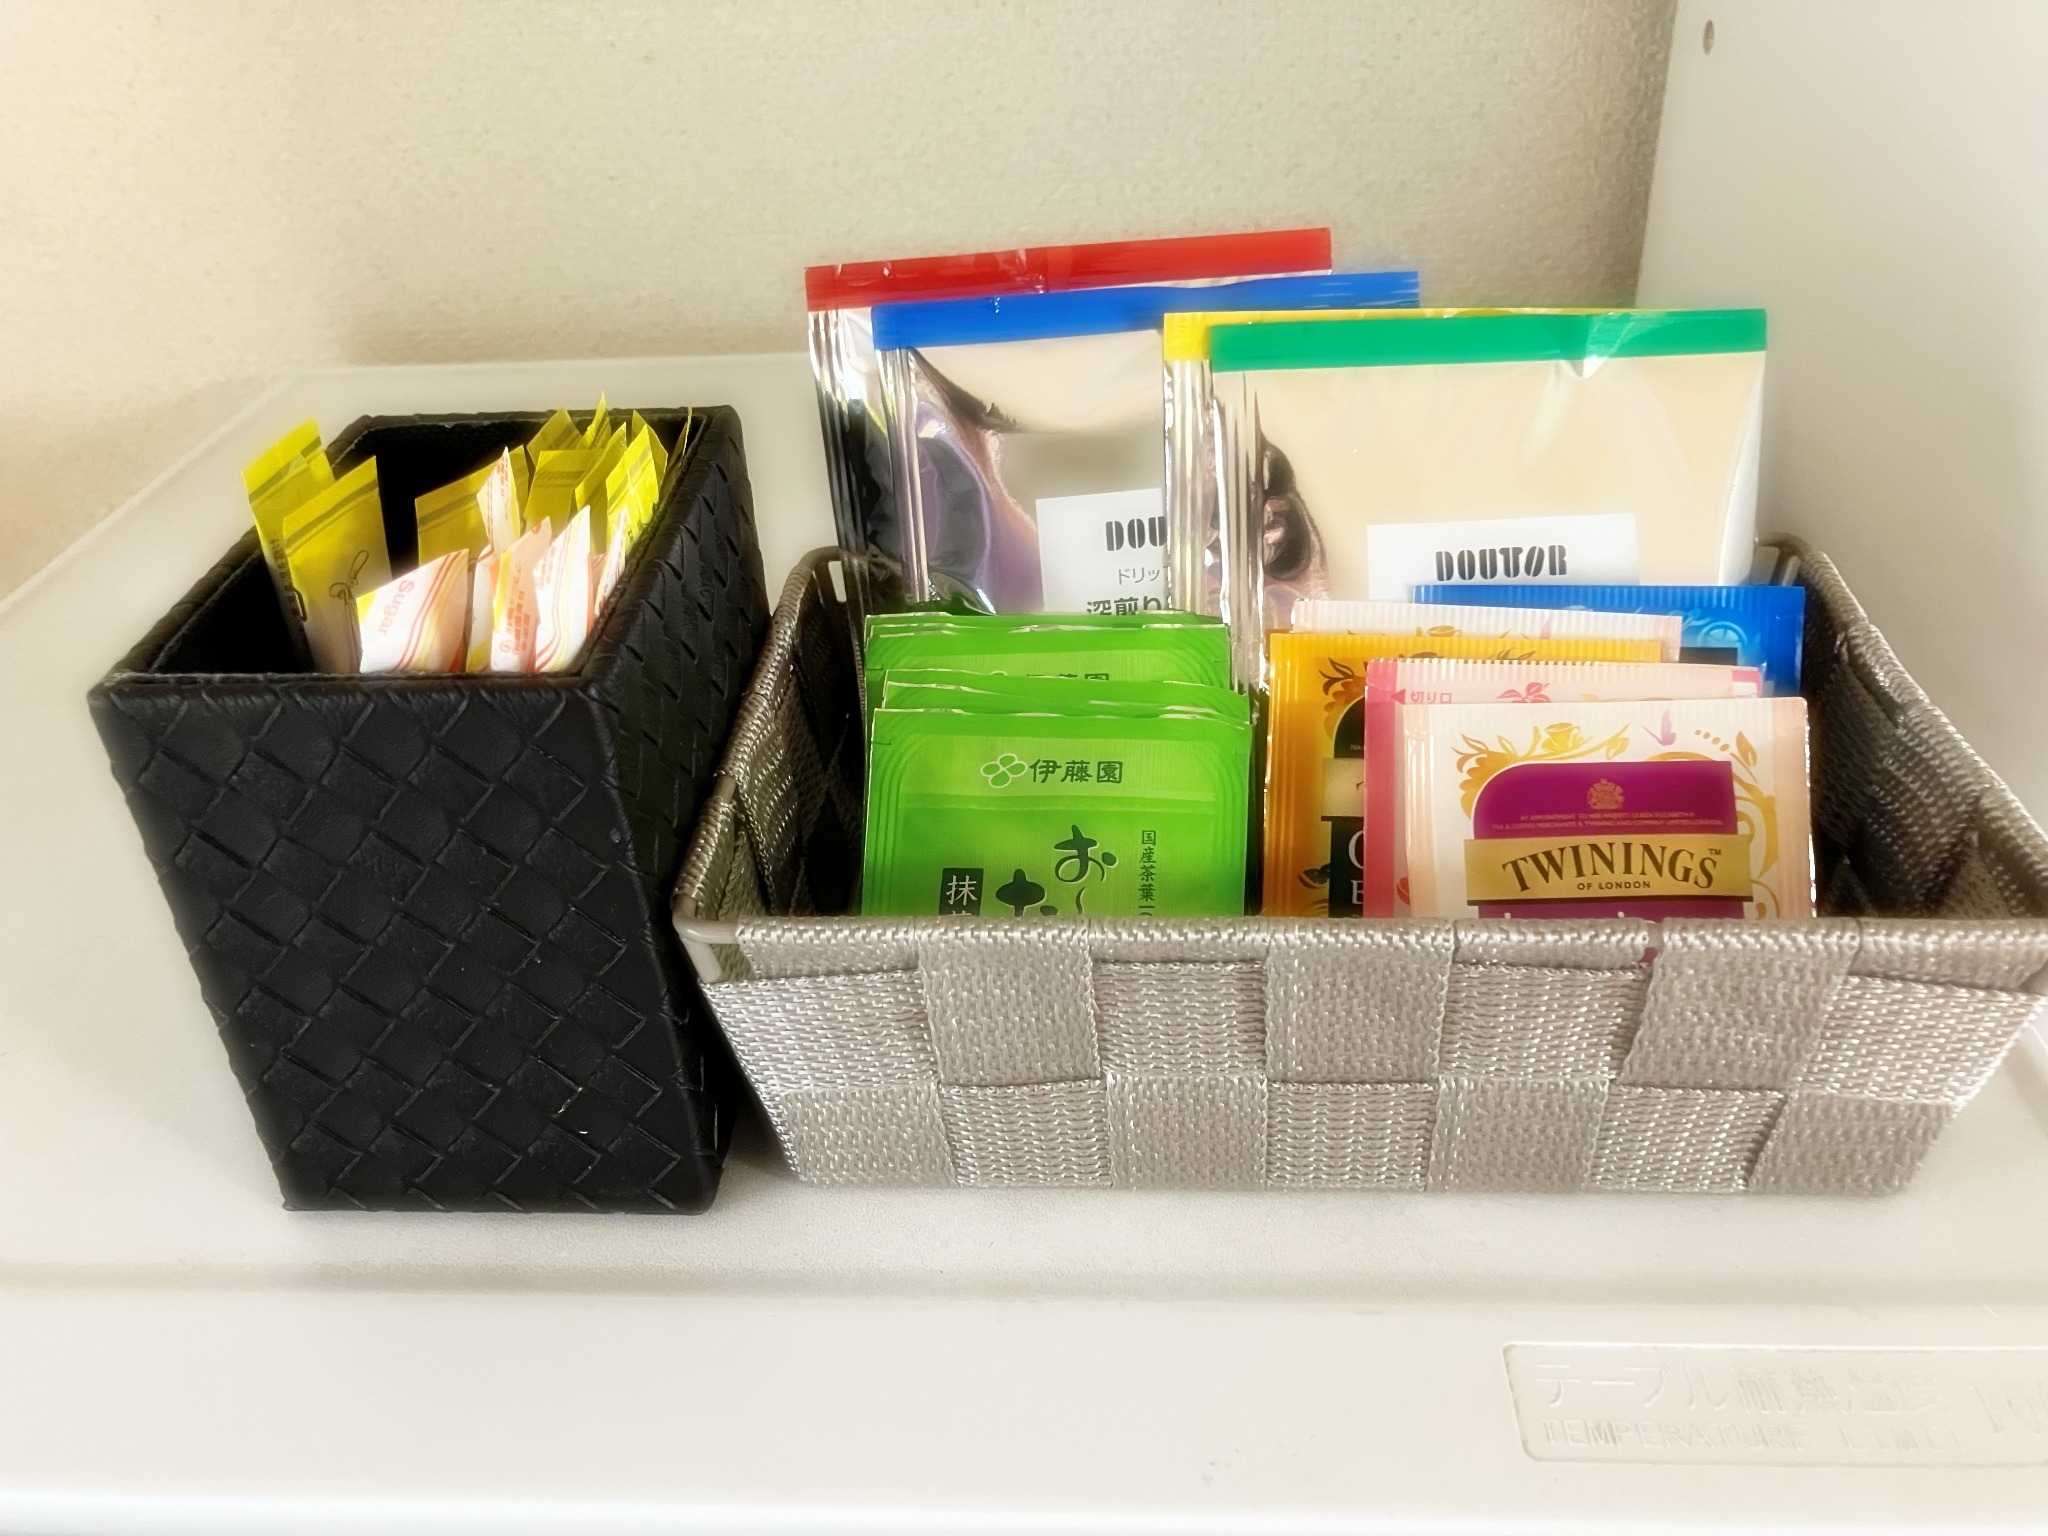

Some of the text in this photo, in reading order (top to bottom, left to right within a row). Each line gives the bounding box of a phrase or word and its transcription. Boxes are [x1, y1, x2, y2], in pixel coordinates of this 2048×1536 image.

[1118, 566, 1168, 585] ドリッ
[1435, 544, 1567, 581] DOUTOR
[379, 580, 415, 636] Sugar
[1410, 690, 1453, 705] 切り口
[1029, 758, 1124, 784] 伊藤園
[1138, 830, 1158, 916] 国産茶葉一
[1502, 841, 1718, 893] TWININGS
[945, 874, 978, 916] 抹
[1577, 880, 1651, 891] OF LONDON
[1542, 1419, 1814, 1453] TEMPERATURE
